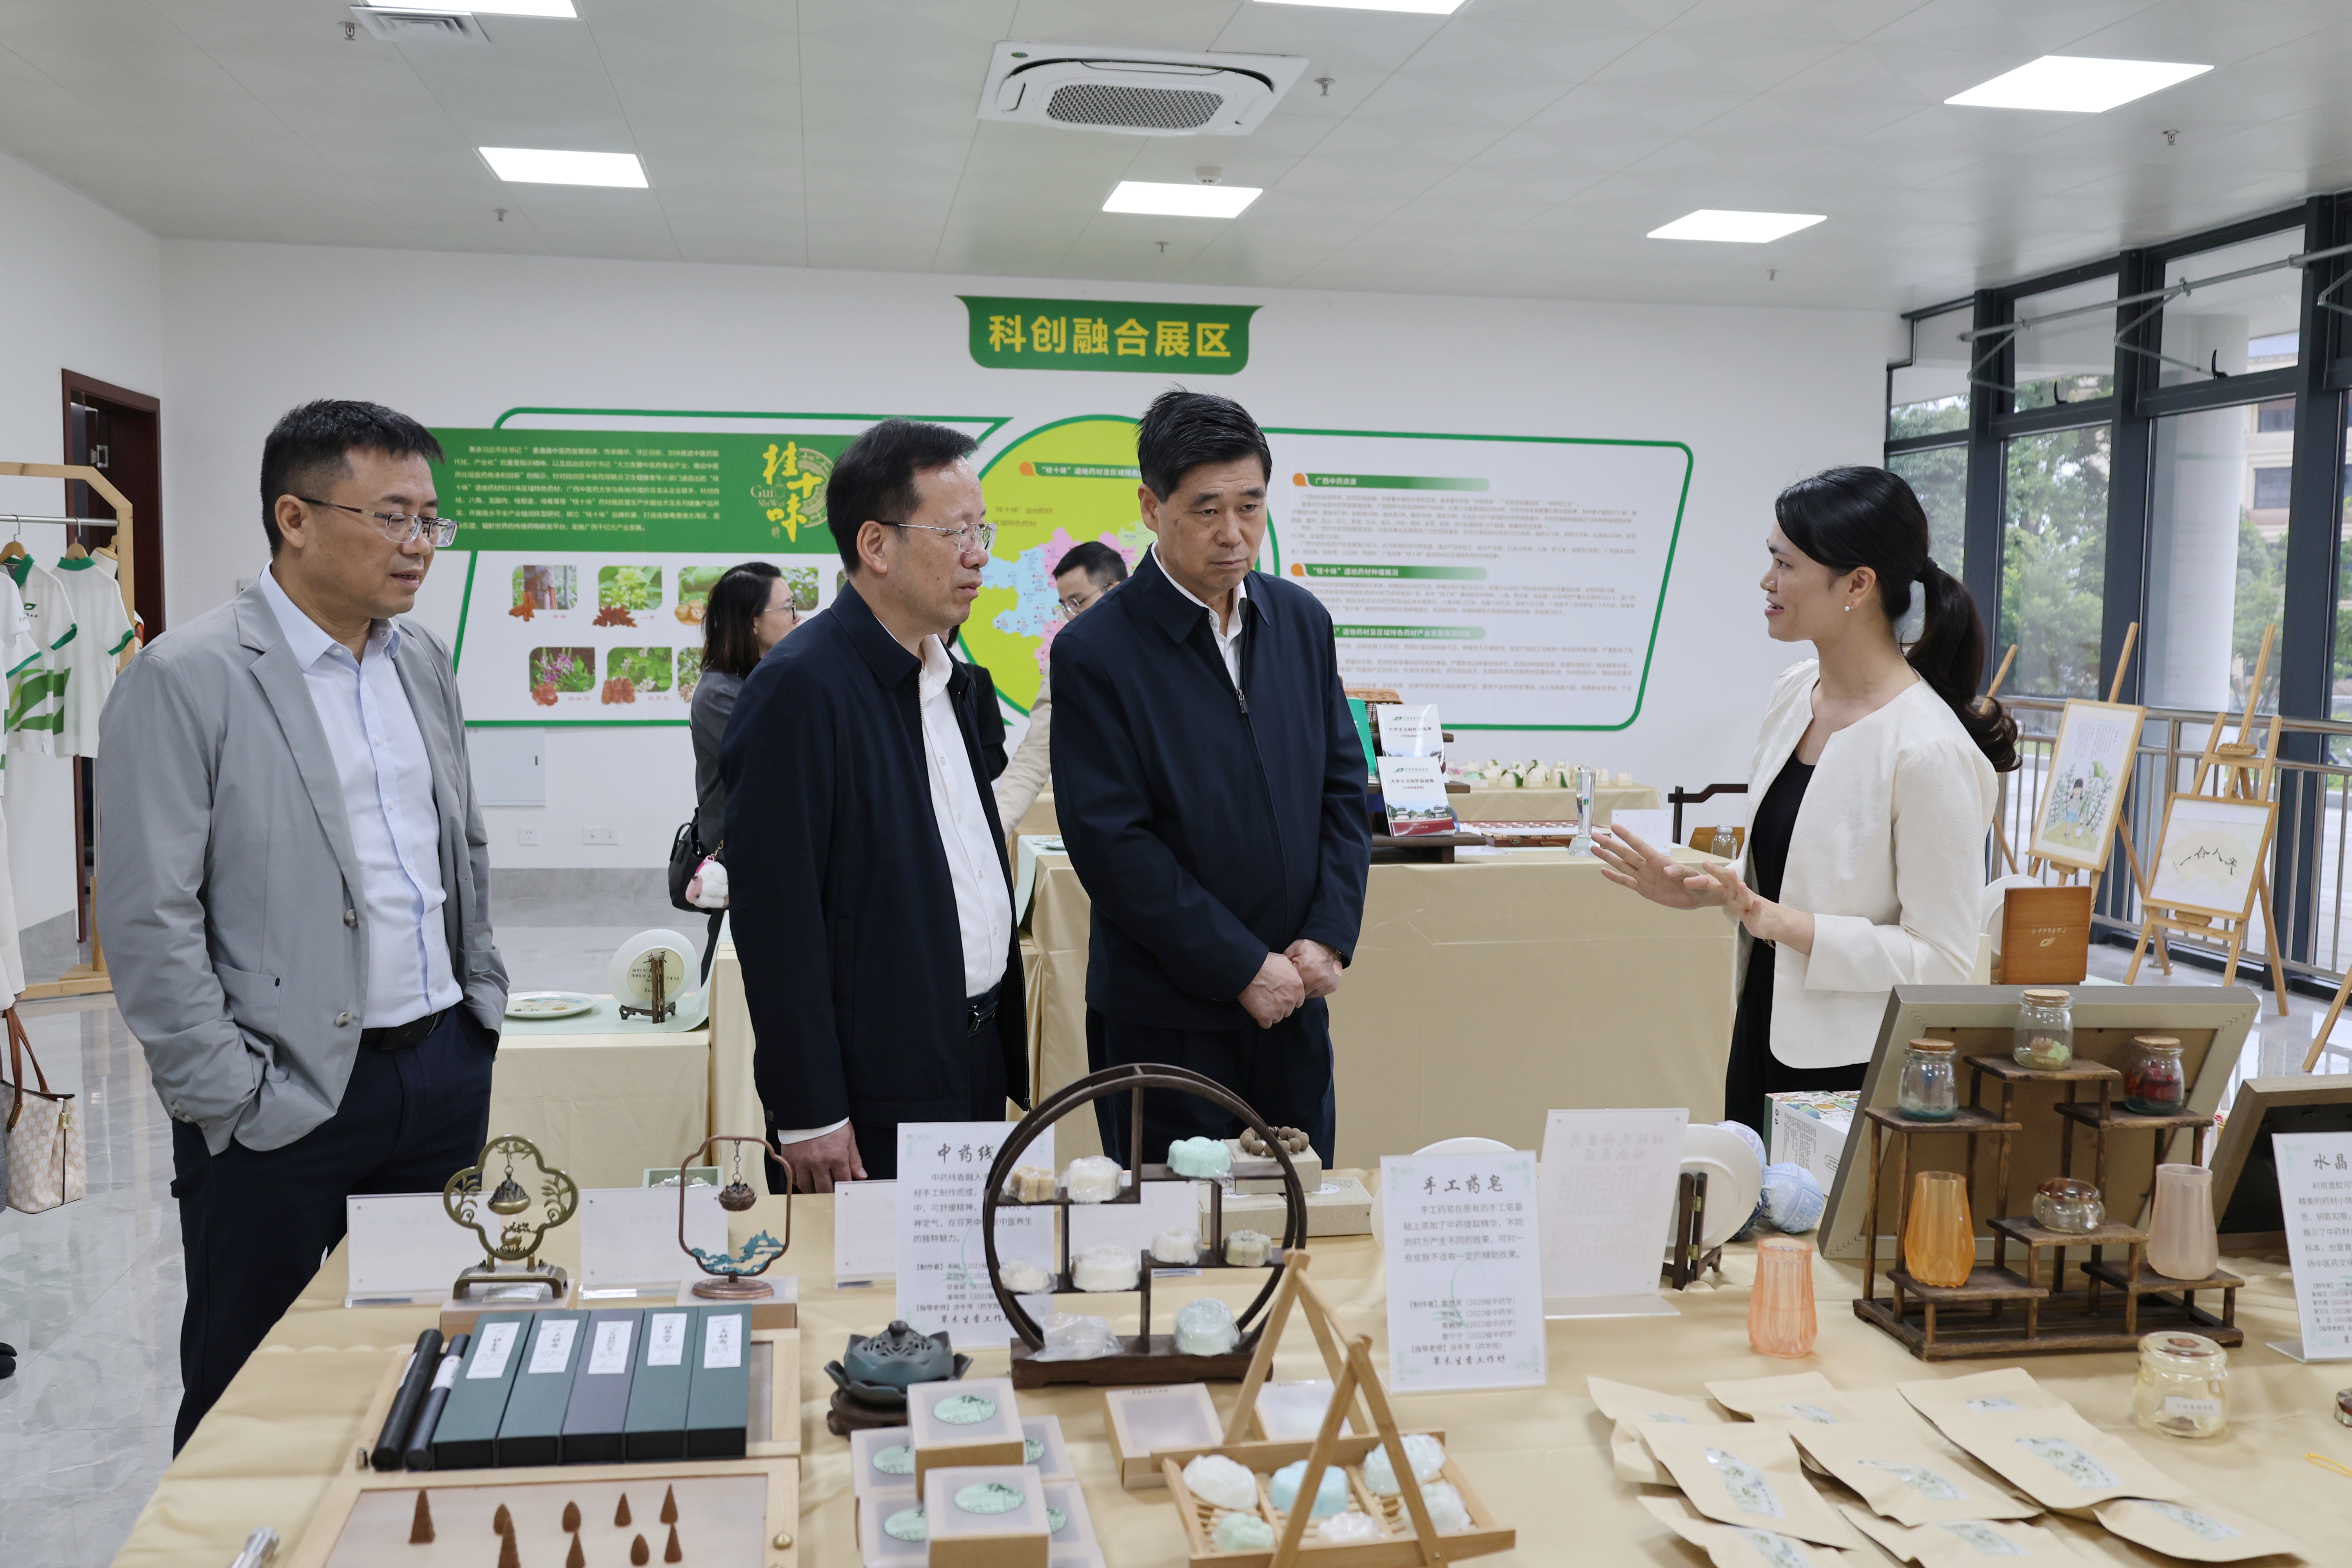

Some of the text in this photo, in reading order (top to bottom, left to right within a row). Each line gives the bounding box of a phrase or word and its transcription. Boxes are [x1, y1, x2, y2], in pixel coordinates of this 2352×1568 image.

[989, 315, 1231, 358] 科创融合展区
[750, 485, 773, 497] Gui
[762, 441, 824, 543] 桂十味
[938, 1143, 994, 1163] 中药线
[2314, 1153, 2347, 1171] 水晶
[1423, 1173, 1503, 1195] 手工药皂
